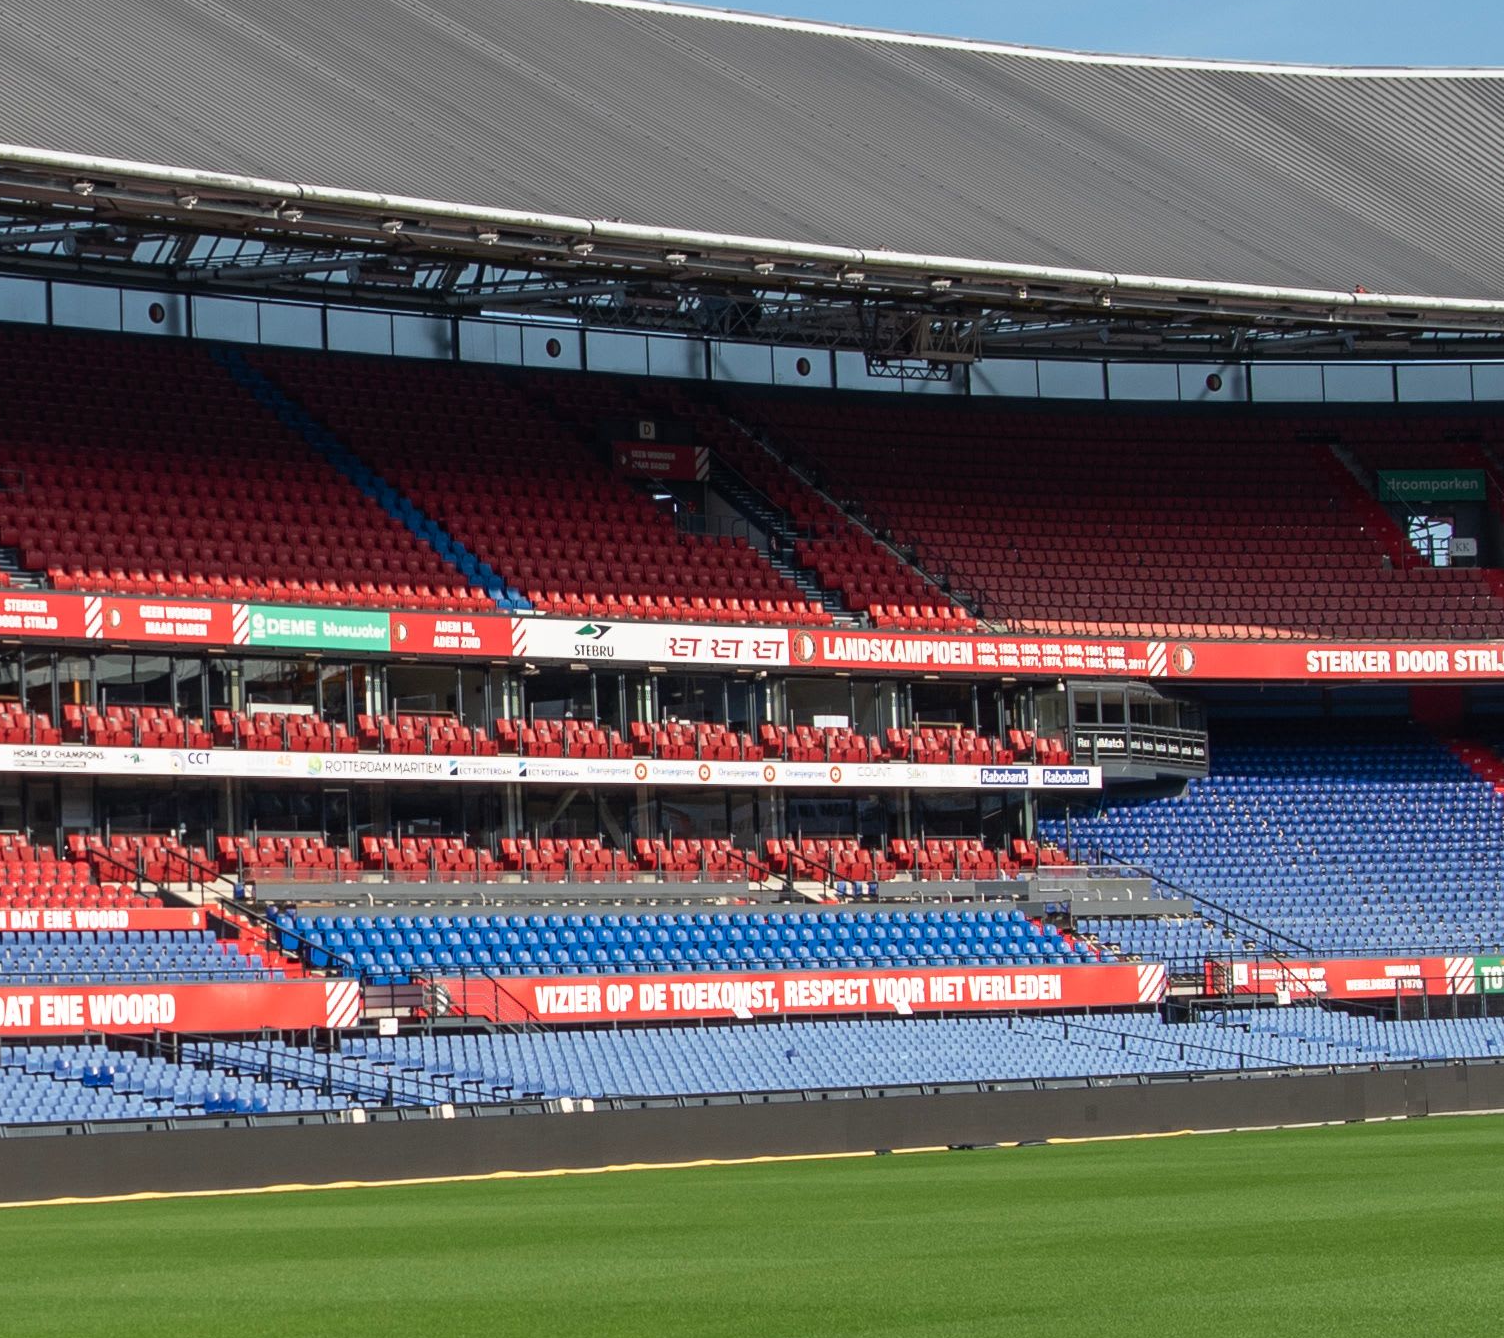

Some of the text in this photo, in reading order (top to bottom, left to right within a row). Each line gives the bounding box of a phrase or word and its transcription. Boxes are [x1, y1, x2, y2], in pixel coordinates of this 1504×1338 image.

[1387, 477, 1478, 494] droomparken
[267, 618, 387, 640] DEME bluewater
[574, 644, 615, 658] STEBRU
[669, 637, 784, 660] RET RET RET
[823, 636, 973, 665] LANDSKAMPIOEN
[1306, 650, 1391, 673] STERKER
[1396, 650, 1449, 672] DOOR
[188, 752, 211, 765] CCT
[325, 760, 443, 775] ROTTERDAM MARITIEM
[982, 769, 1089, 784] Rabobank Rabobank
[10, 910, 39, 929] DAT
[42, 910, 73, 929] ENE
[74, 910, 129, 929] WOORD
[535, 974, 1063, 1015] VIZIER OP DE TOEKOMST, RESPECT VOOR HET VERLEDEN
[38, 994, 85, 1026] ENE
[87, 992, 177, 1026] WOORD
